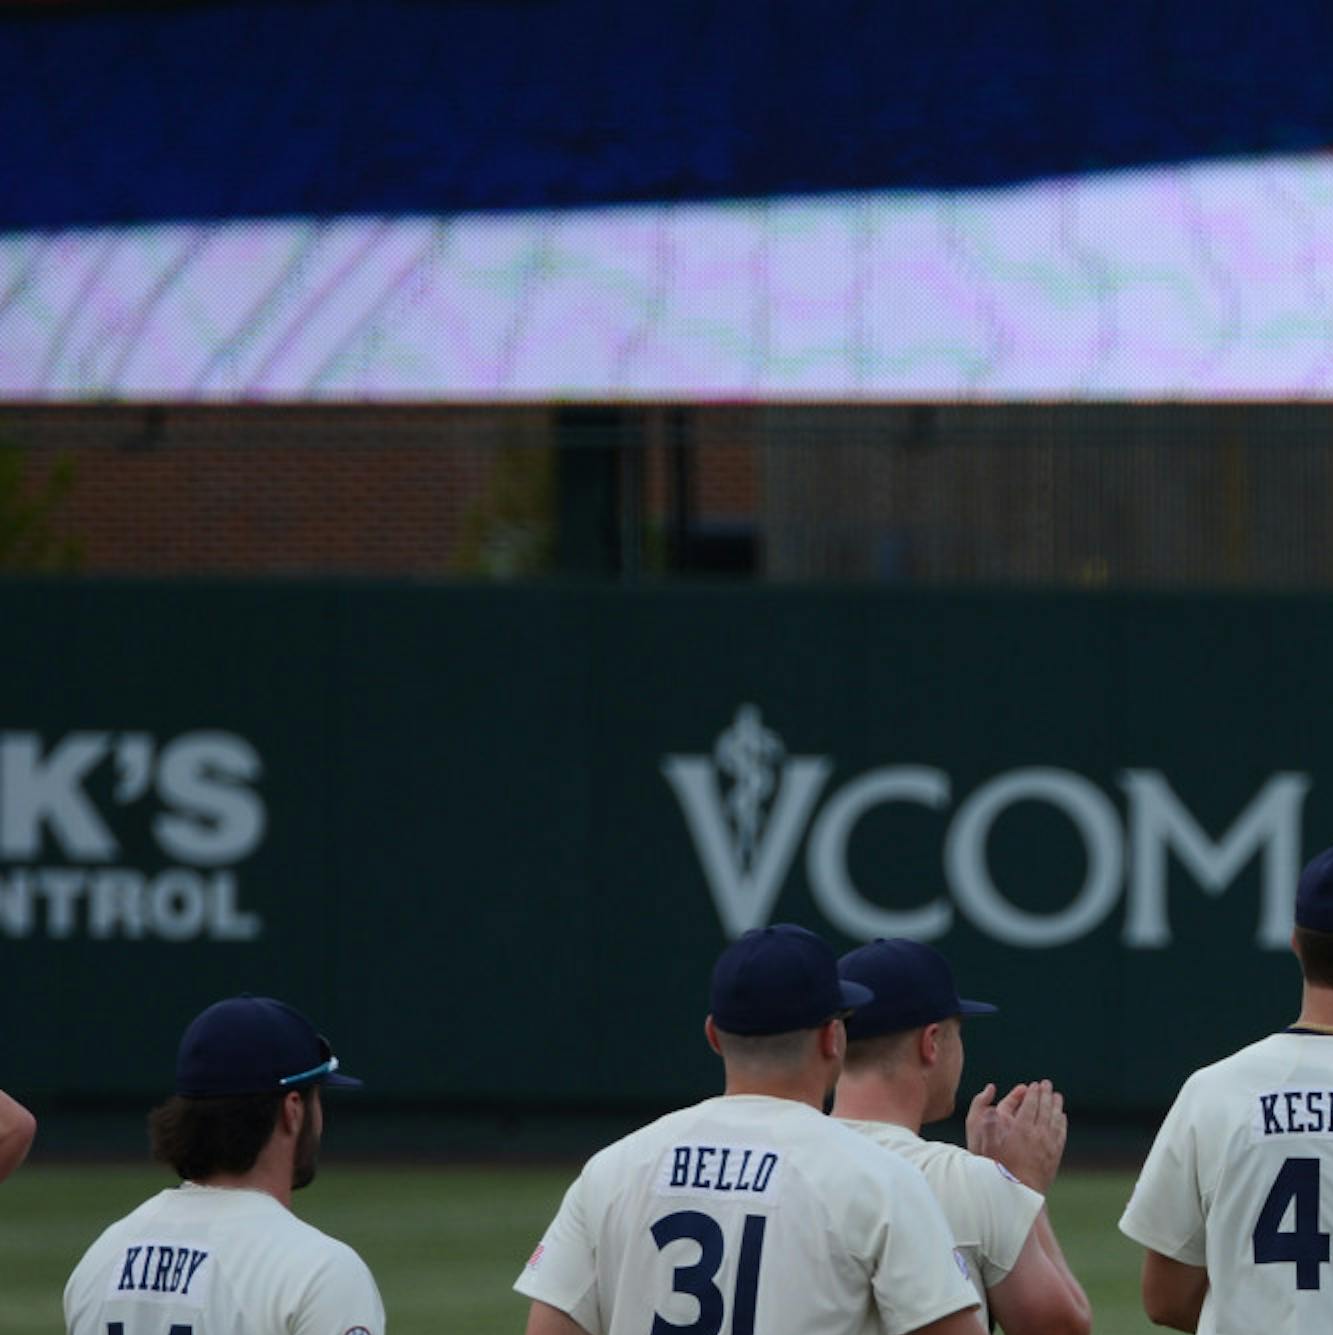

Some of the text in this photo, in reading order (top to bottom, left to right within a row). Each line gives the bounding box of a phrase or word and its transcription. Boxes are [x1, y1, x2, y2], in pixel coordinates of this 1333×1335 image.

[0, 730, 266, 865] K'S
[661, 752, 1312, 949] VCOM
[670, 1146, 779, 1192] BELLO
[118, 1246, 208, 1295] KIRBY
